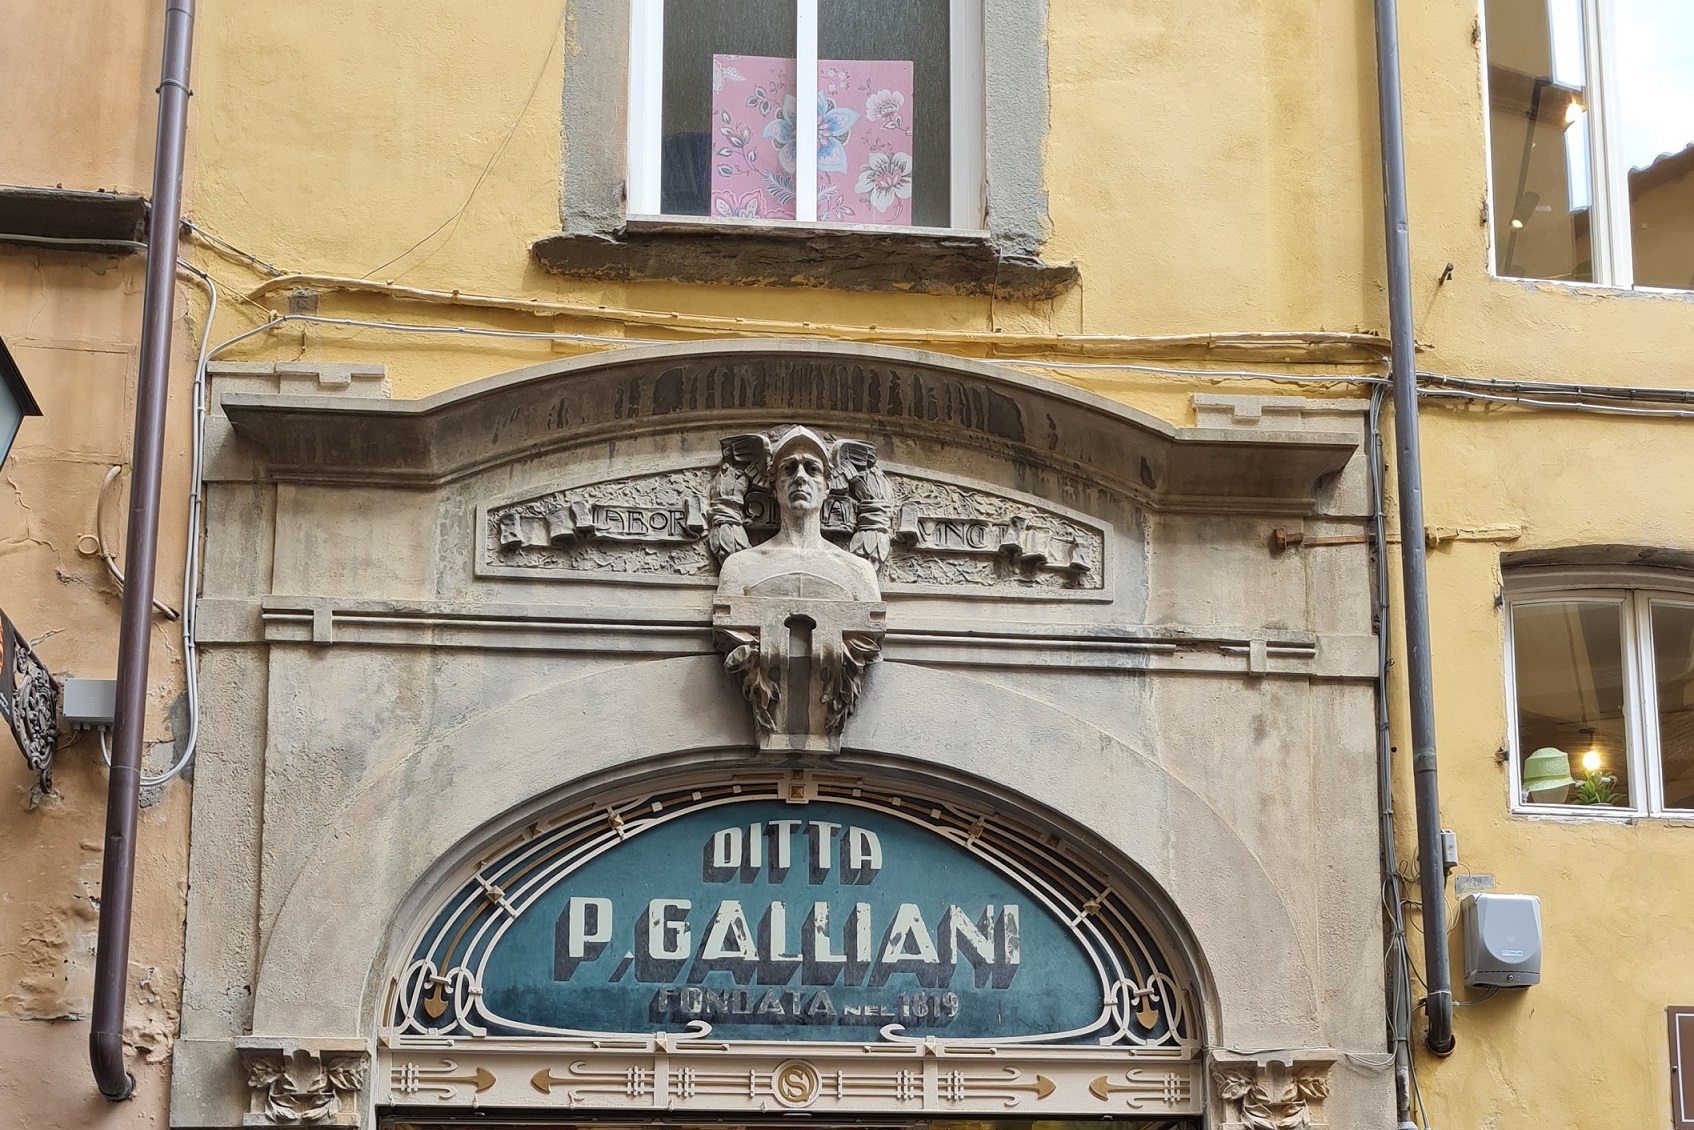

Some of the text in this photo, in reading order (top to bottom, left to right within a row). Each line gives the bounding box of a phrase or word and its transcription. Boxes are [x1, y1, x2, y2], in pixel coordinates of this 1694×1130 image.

[713, 820, 883, 870] DITTA
[656, 987, 837, 1016] FONDATA
[844, 1004, 896, 1017] NEL
